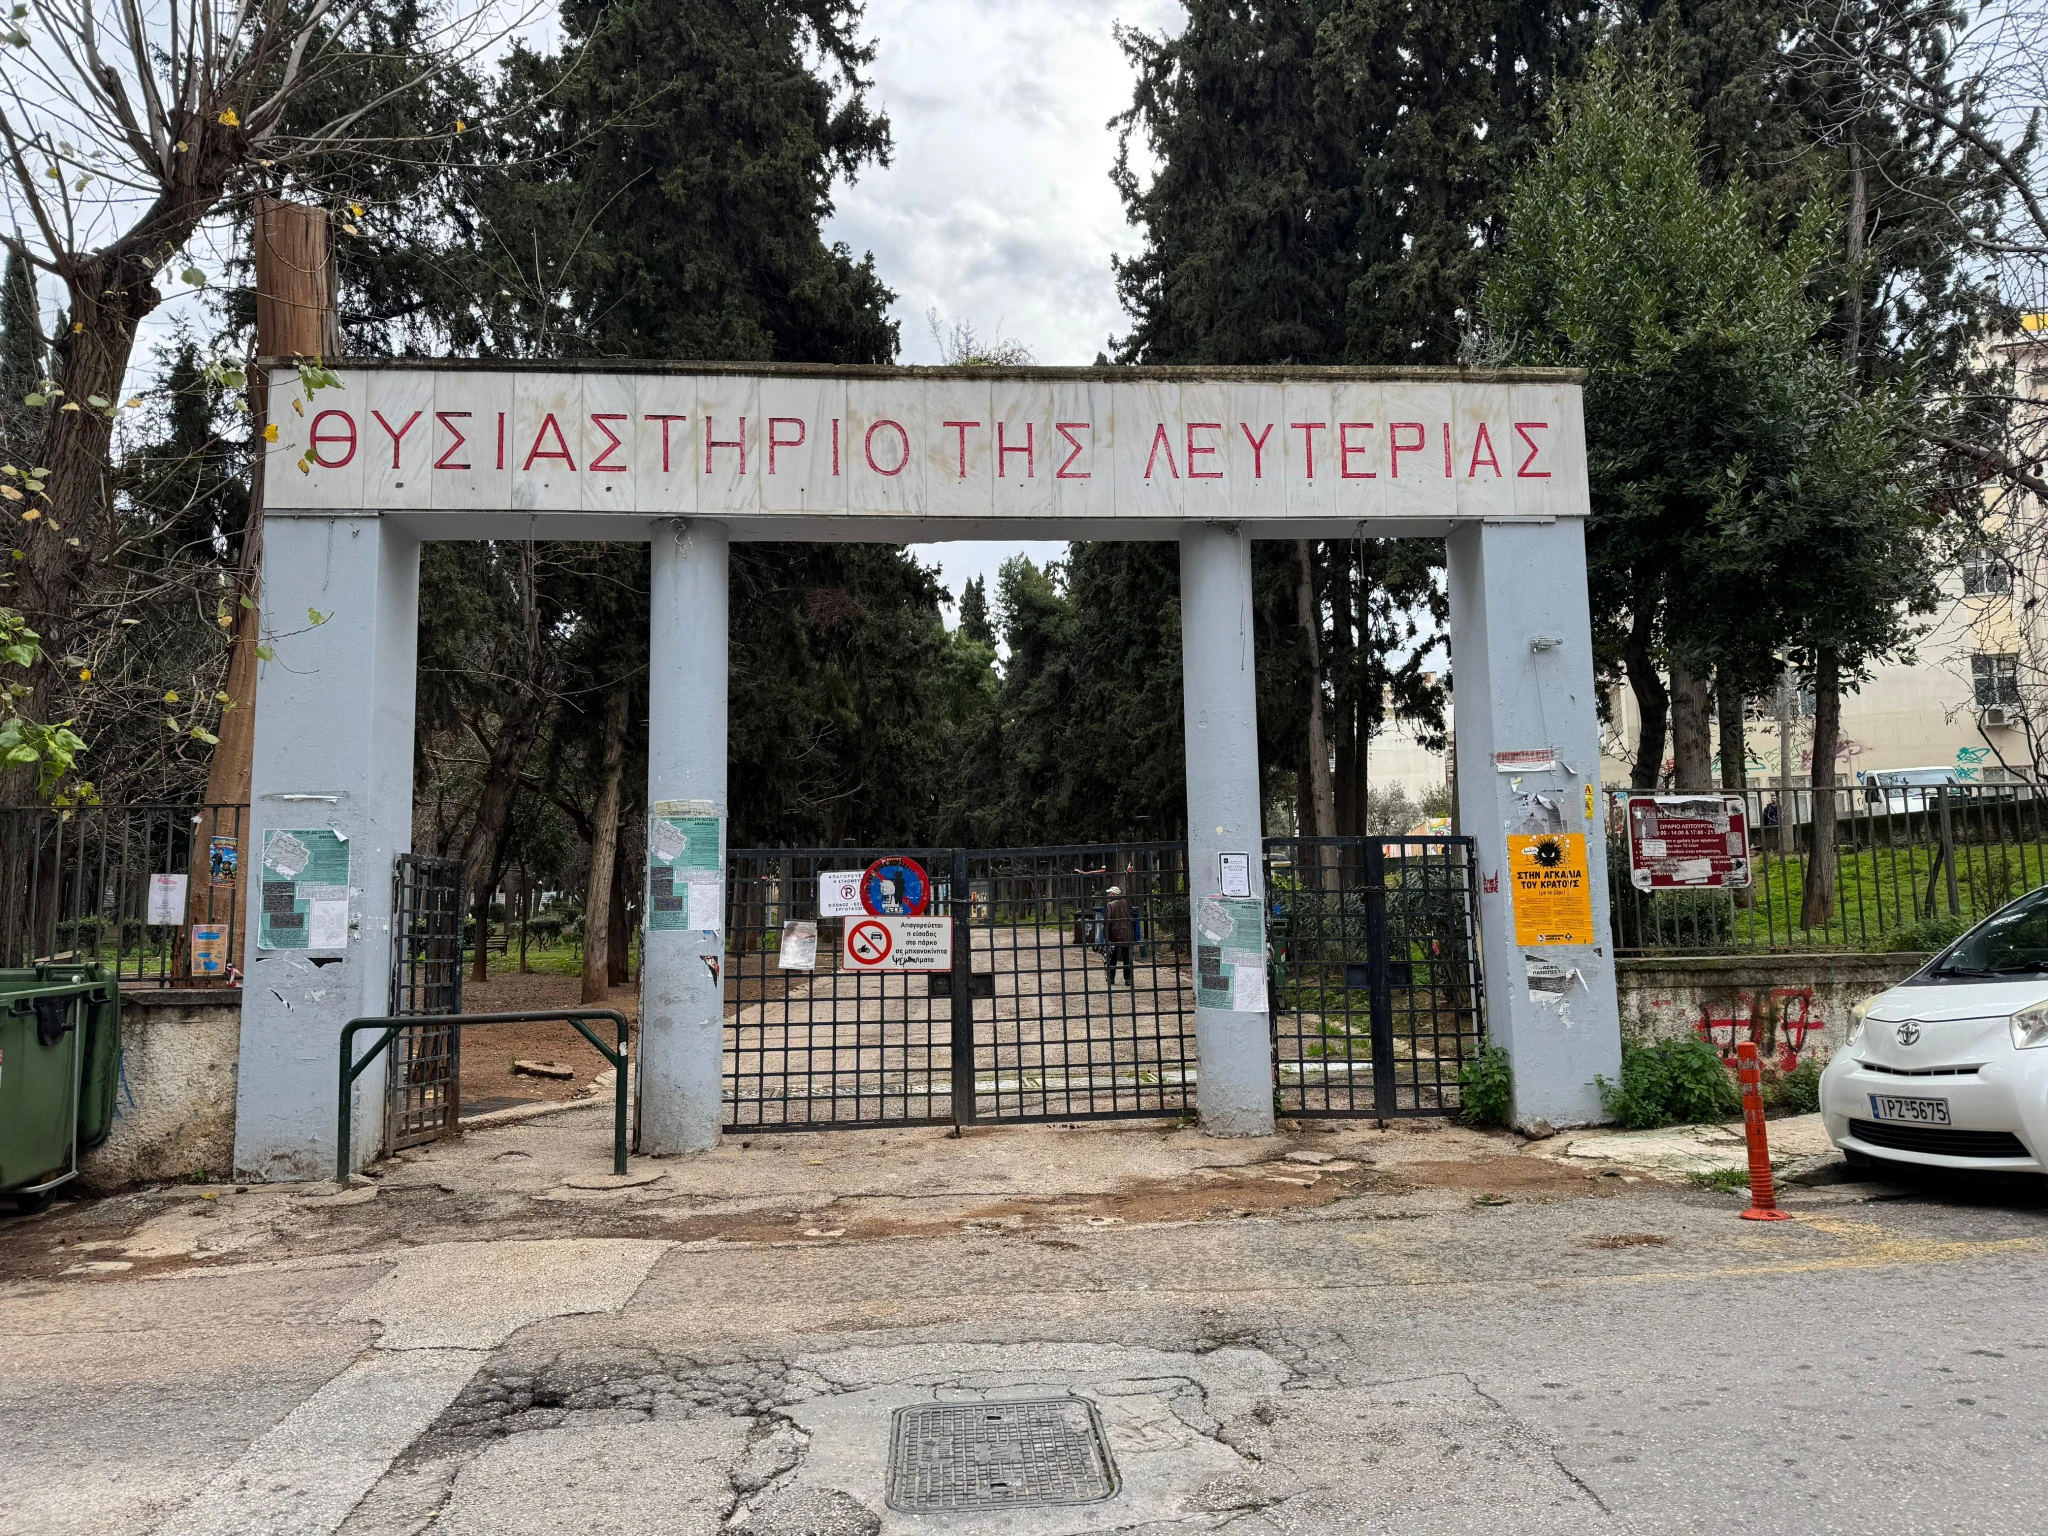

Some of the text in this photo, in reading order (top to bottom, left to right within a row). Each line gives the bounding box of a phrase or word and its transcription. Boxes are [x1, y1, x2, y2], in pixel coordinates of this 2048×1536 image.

[309, 409, 1552, 479] ΘΥΣΙΑΣΤΗΡΙΟ ΤΗΣ ΛΕΥΤΕΡΙΑΣ
[1517, 870, 1582, 880] ΣΤΗΝ ΑΓΚΑΛΙΑ
[1521, 880, 1580, 889] ΤΟΥ ΚΡΑΤΟΥΣ
[900, 921, 944, 929] Απαγορεύεται
[917, 939, 938, 947] πάρκο
[904, 947, 948, 955] μηχανοκίνητα
